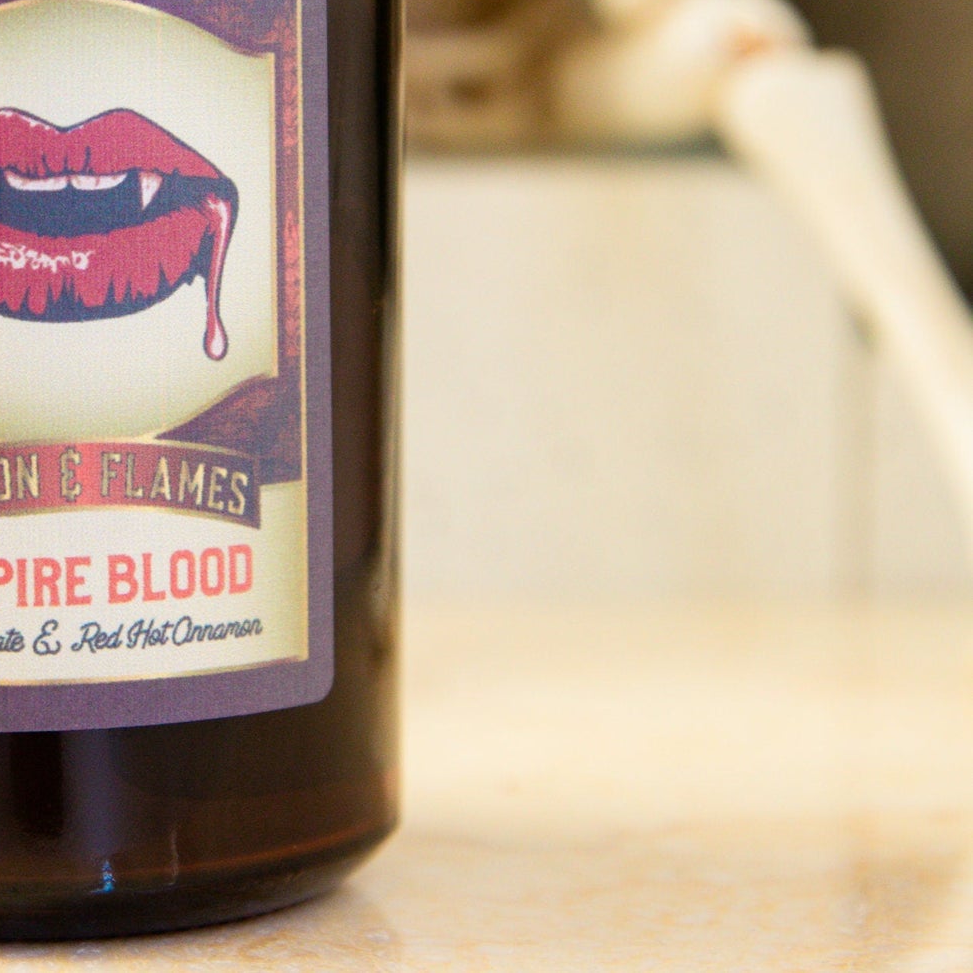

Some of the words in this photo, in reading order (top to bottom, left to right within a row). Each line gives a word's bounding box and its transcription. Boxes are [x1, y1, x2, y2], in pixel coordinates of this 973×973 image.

[59, 446, 83, 503] &
[100, 451, 249, 516] FLAMES
[107, 543, 254, 604] BLOOD
[32, 619, 61, 656] &
[71, 621, 122, 654] Red
[126, 618, 170, 650] Hot
